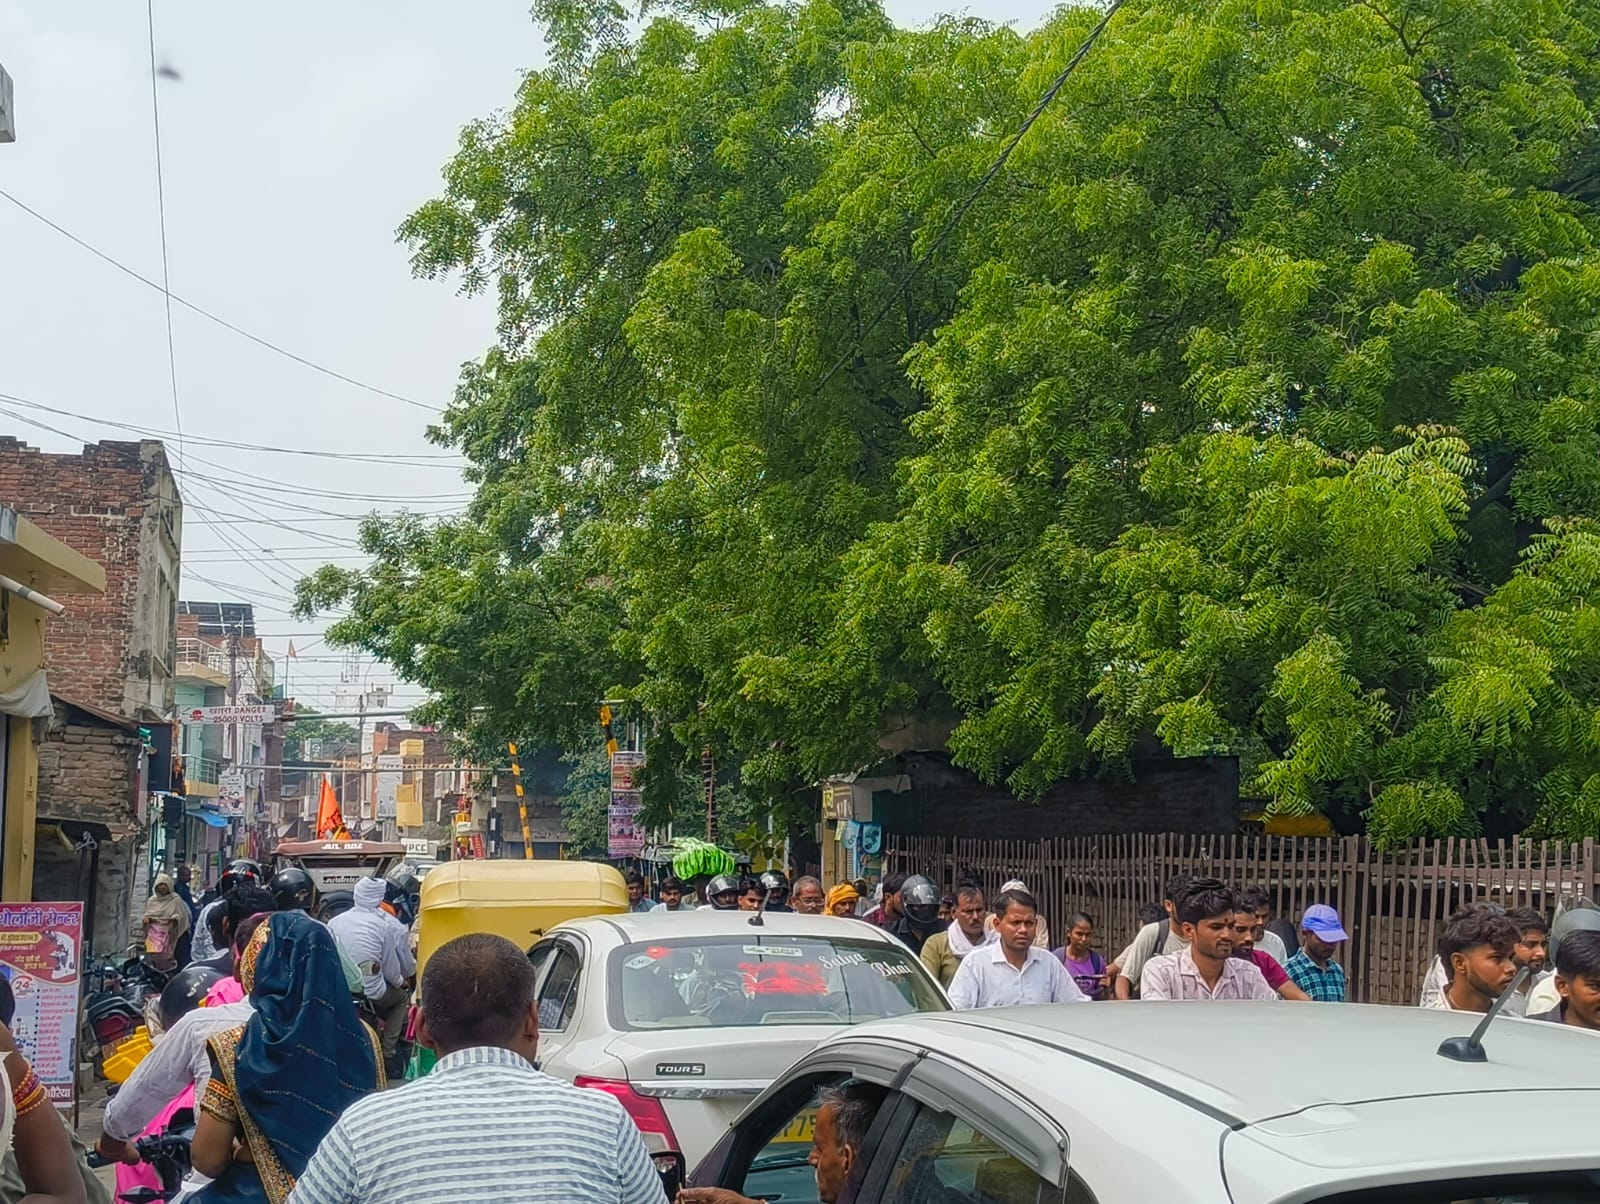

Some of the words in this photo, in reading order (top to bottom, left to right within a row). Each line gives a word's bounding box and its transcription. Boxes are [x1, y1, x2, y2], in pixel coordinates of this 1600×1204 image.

[234, 706, 267, 714] DANGER
[213, 715, 238, 724] 25000
[240, 715, 264, 723] VOLTS
